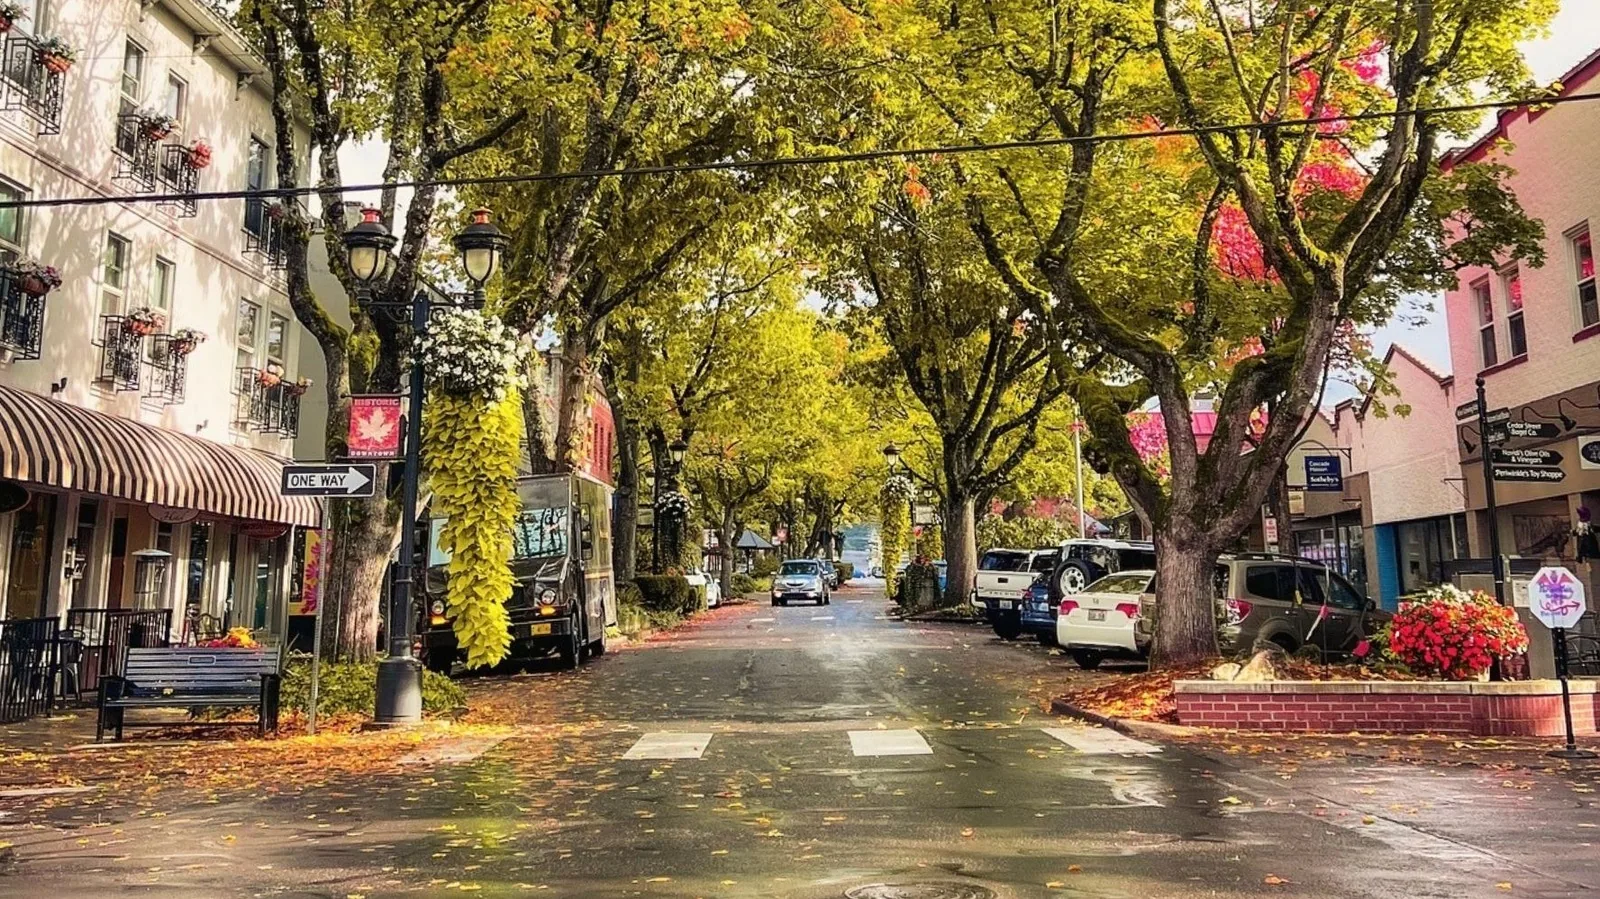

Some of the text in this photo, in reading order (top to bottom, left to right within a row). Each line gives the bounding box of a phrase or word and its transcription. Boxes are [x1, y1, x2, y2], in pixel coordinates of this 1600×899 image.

[1511, 429, 1527, 437] Bagel
[1516, 456, 1543, 465] Vinegars
[1530, 470, 1540, 479] Toy
[1540, 470, 1563, 479] Shoppe
[291, 475, 346, 487] ONE WAY
[1310, 475, 1339, 484] Sotheby's
